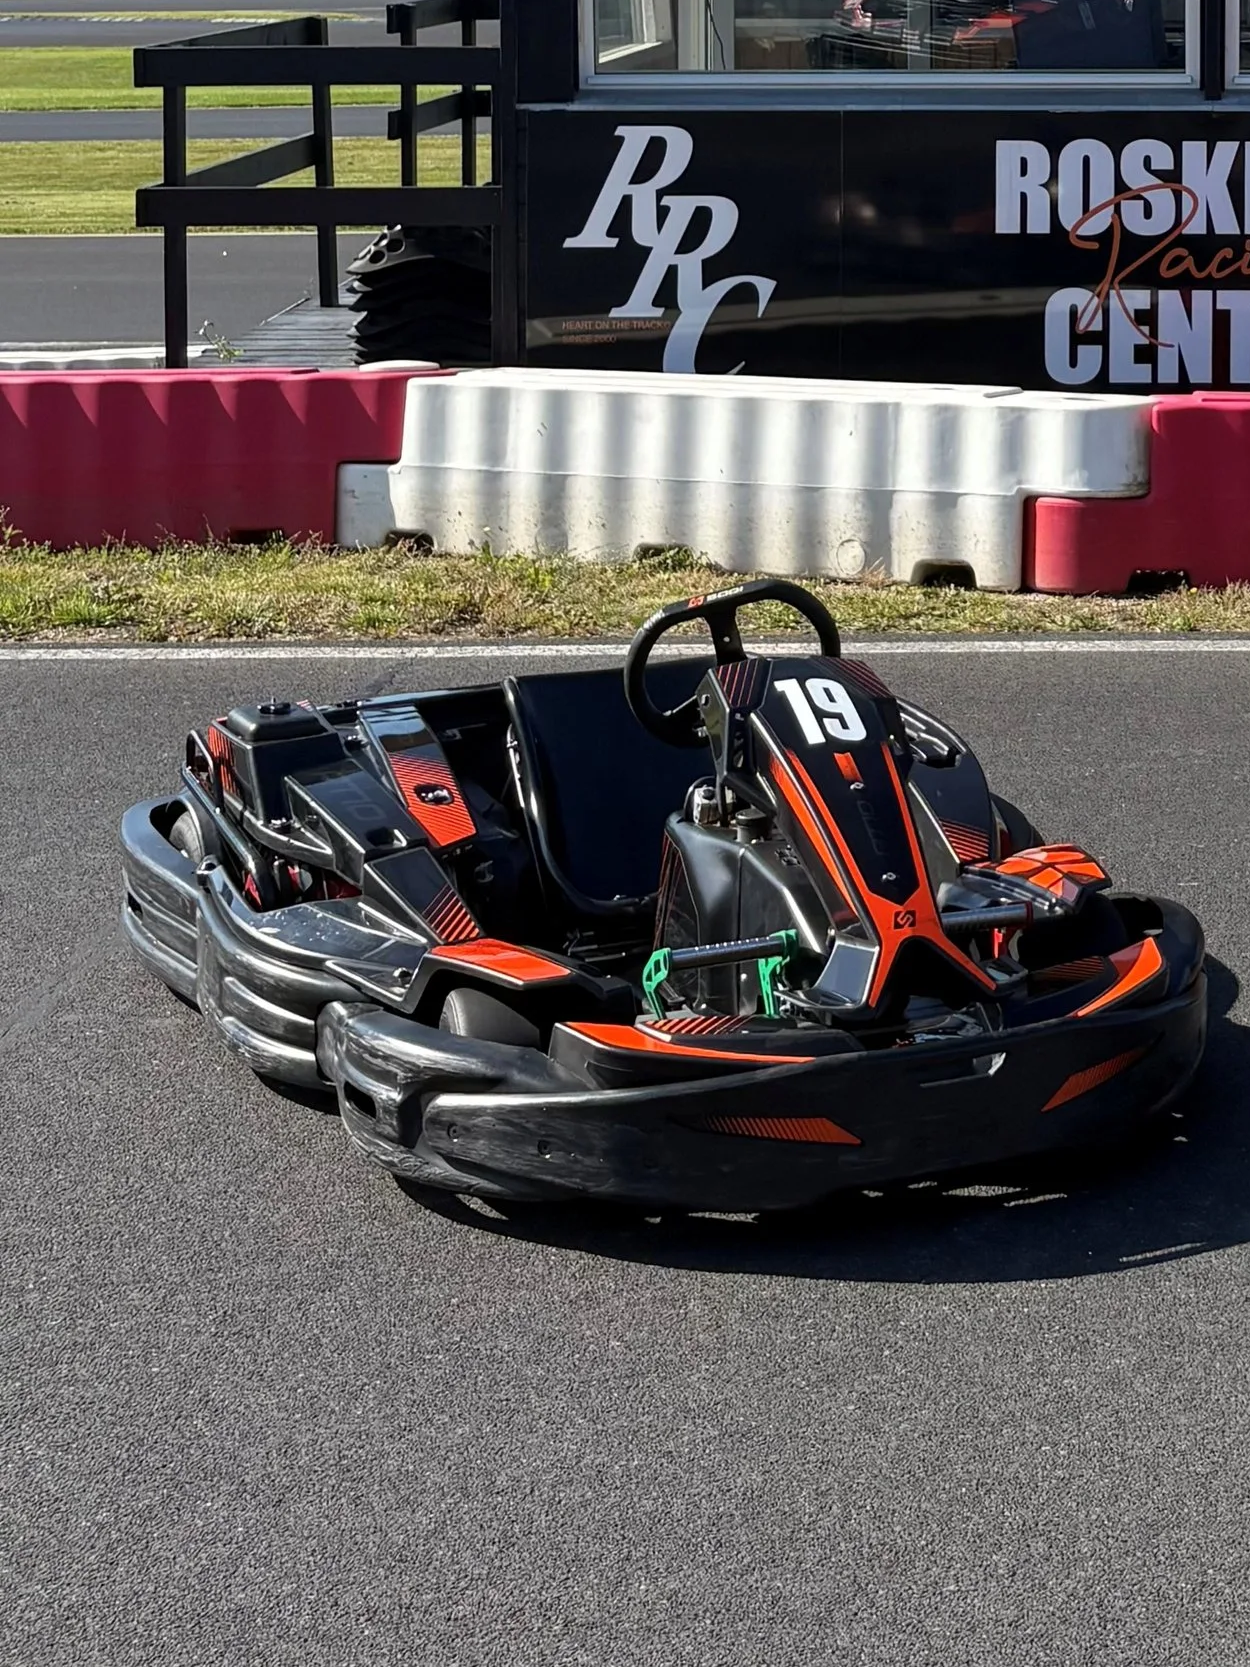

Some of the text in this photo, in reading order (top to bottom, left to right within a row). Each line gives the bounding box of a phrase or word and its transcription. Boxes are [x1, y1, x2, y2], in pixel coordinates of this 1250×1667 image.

[562, 125, 778, 375] RRC
[562, 320, 593, 331] HEART
[595, 320, 610, 331] ON
[612, 320, 633, 331] THE
[773, 677, 868, 745] 19
